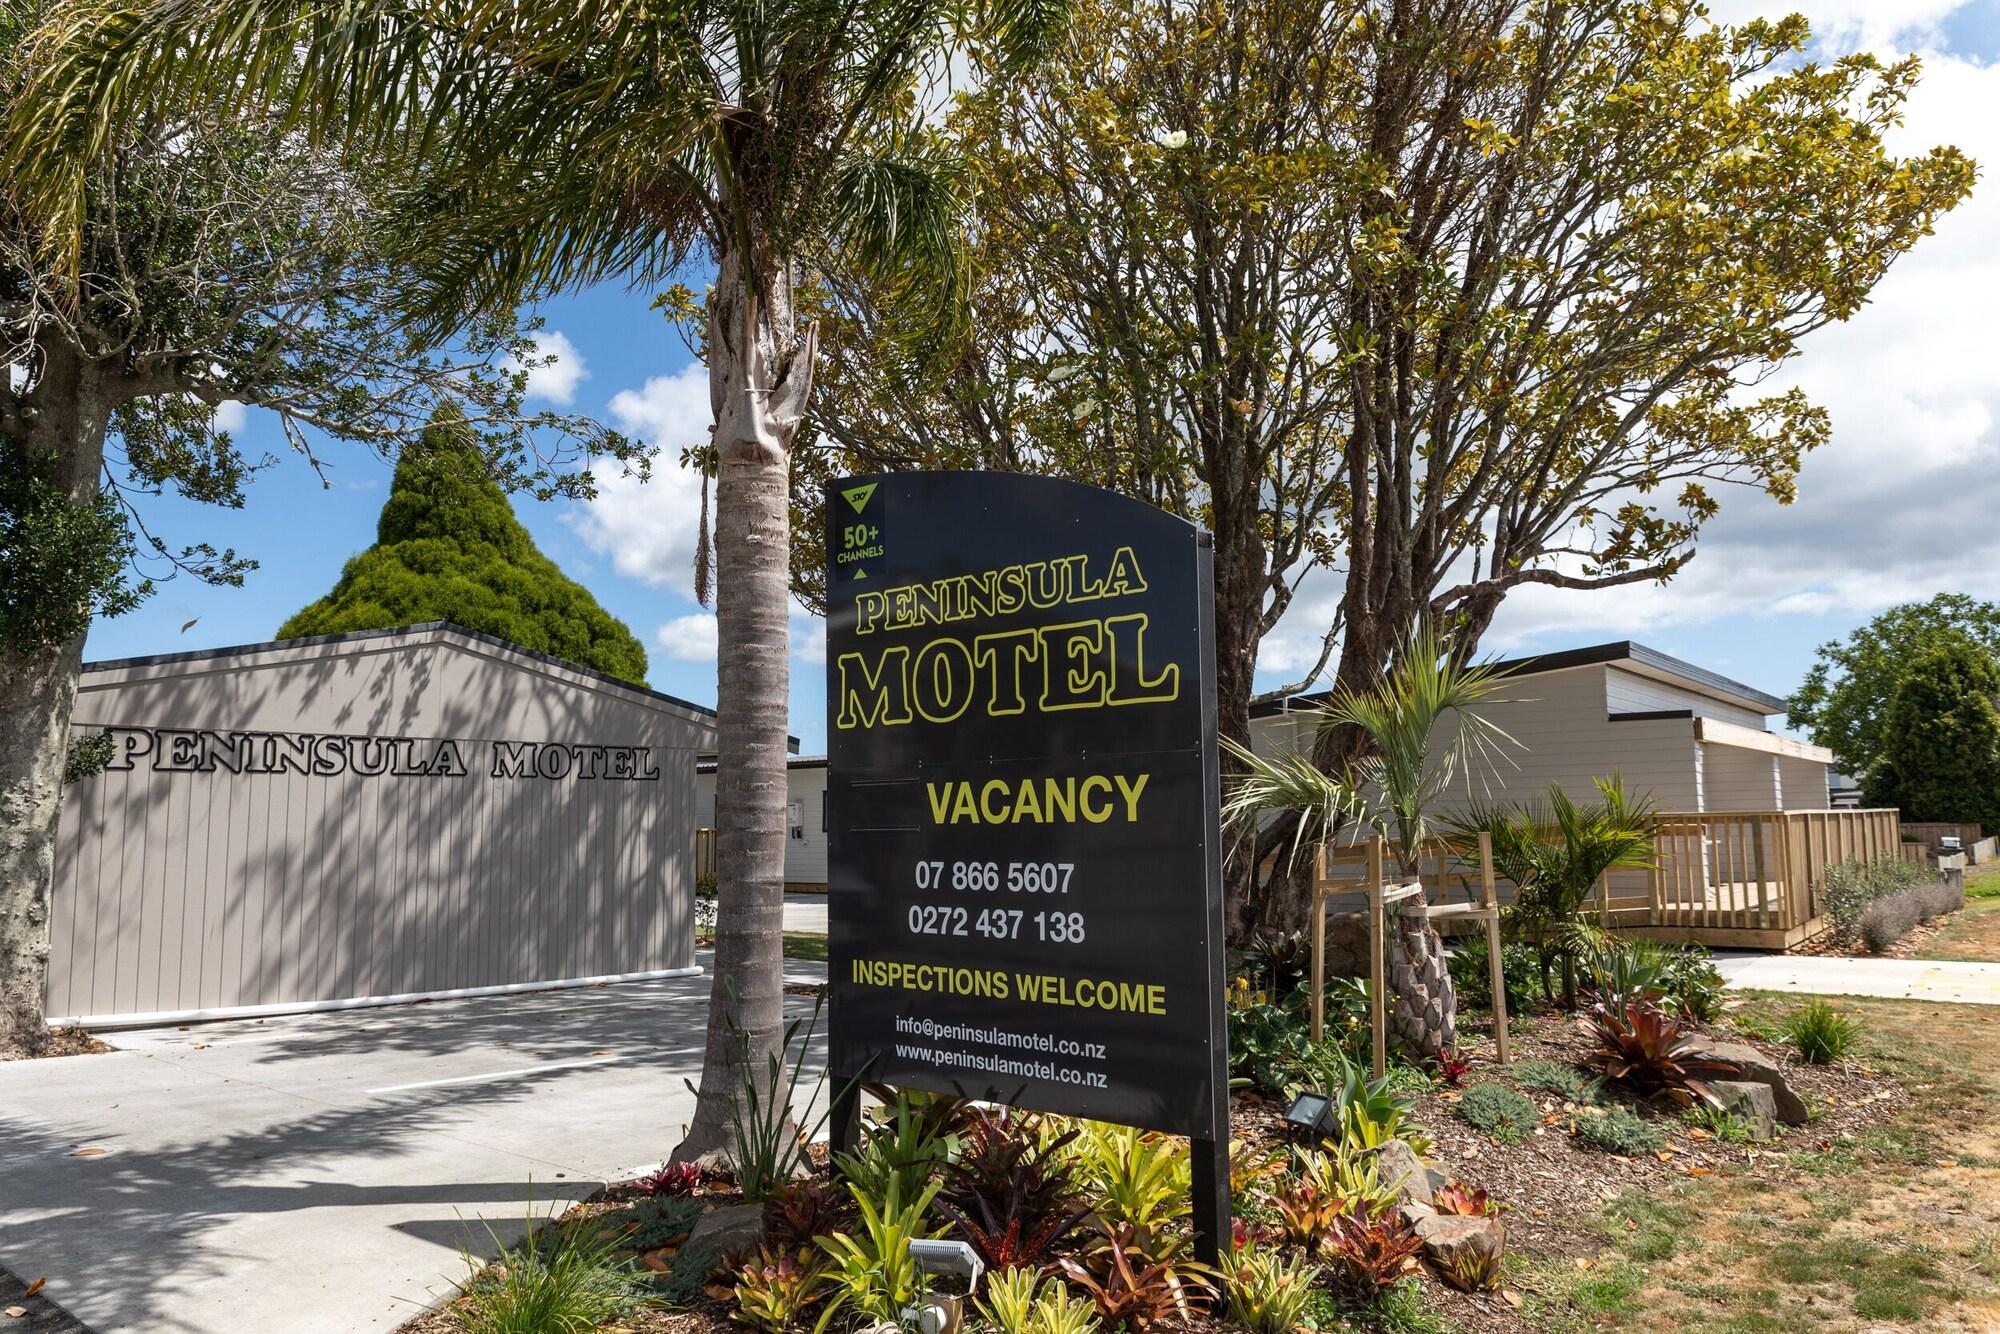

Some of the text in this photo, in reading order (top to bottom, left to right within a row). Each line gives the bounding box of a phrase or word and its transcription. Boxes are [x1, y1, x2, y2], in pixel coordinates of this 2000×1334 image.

[852, 491, 868, 502] SKY
[837, 545, 884, 564] CHANNELS
[844, 524, 879, 549] 50+
[856, 546, 1148, 635] PENINSULA
[837, 613, 1180, 729] MOTEL
[104, 727, 660, 781] PENINSULA MOTEL
[926, 774, 1150, 825] VACANCY
[915, 861, 1074, 894] 07 866 5607
[908, 905, 1085, 944] 0272 437 138
[852, 959, 1166, 1015] INSPECTIONS WELCOME
[896, 1015, 1106, 1059] info@peninsulamotel.co.nz
[896, 1044, 1108, 1088] www.peninsulamotel.co.nz
